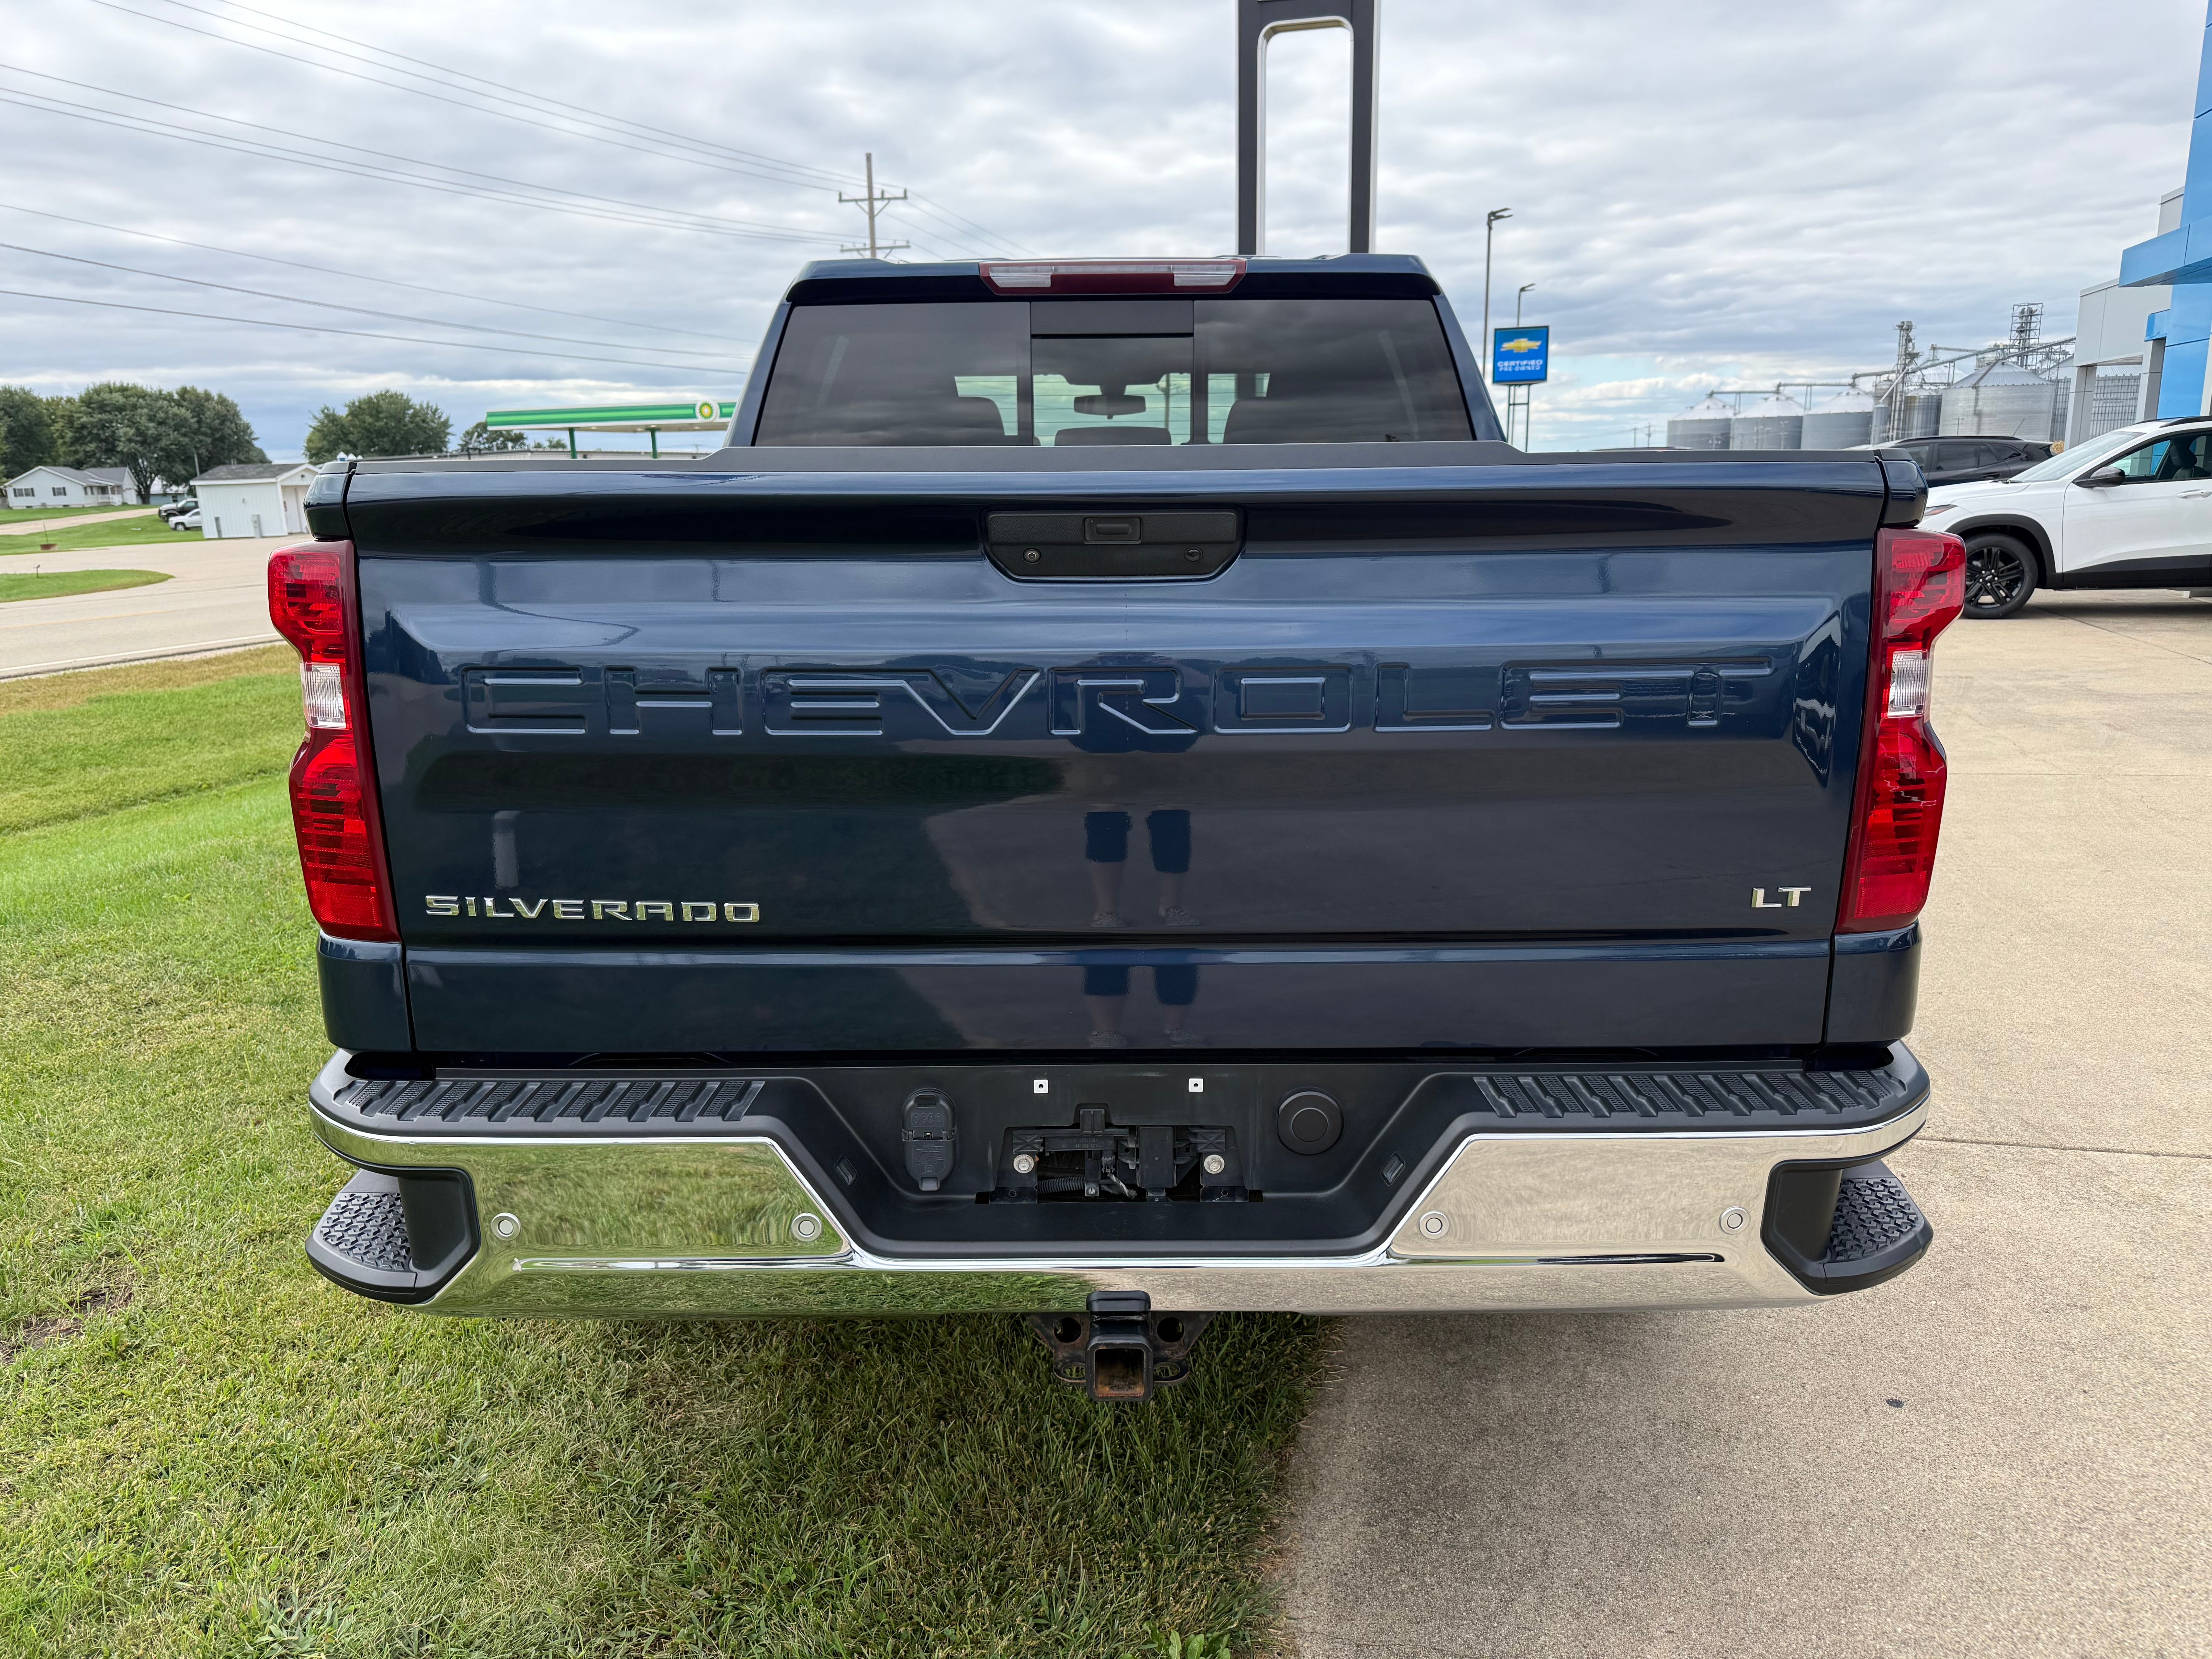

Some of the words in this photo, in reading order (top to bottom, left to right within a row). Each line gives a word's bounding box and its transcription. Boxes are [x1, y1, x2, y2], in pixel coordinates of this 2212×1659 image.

[461, 657, 1773, 735] CHEVROLET
[425, 895, 760, 922] SILVERADO
[1751, 886, 1812, 908] LT
